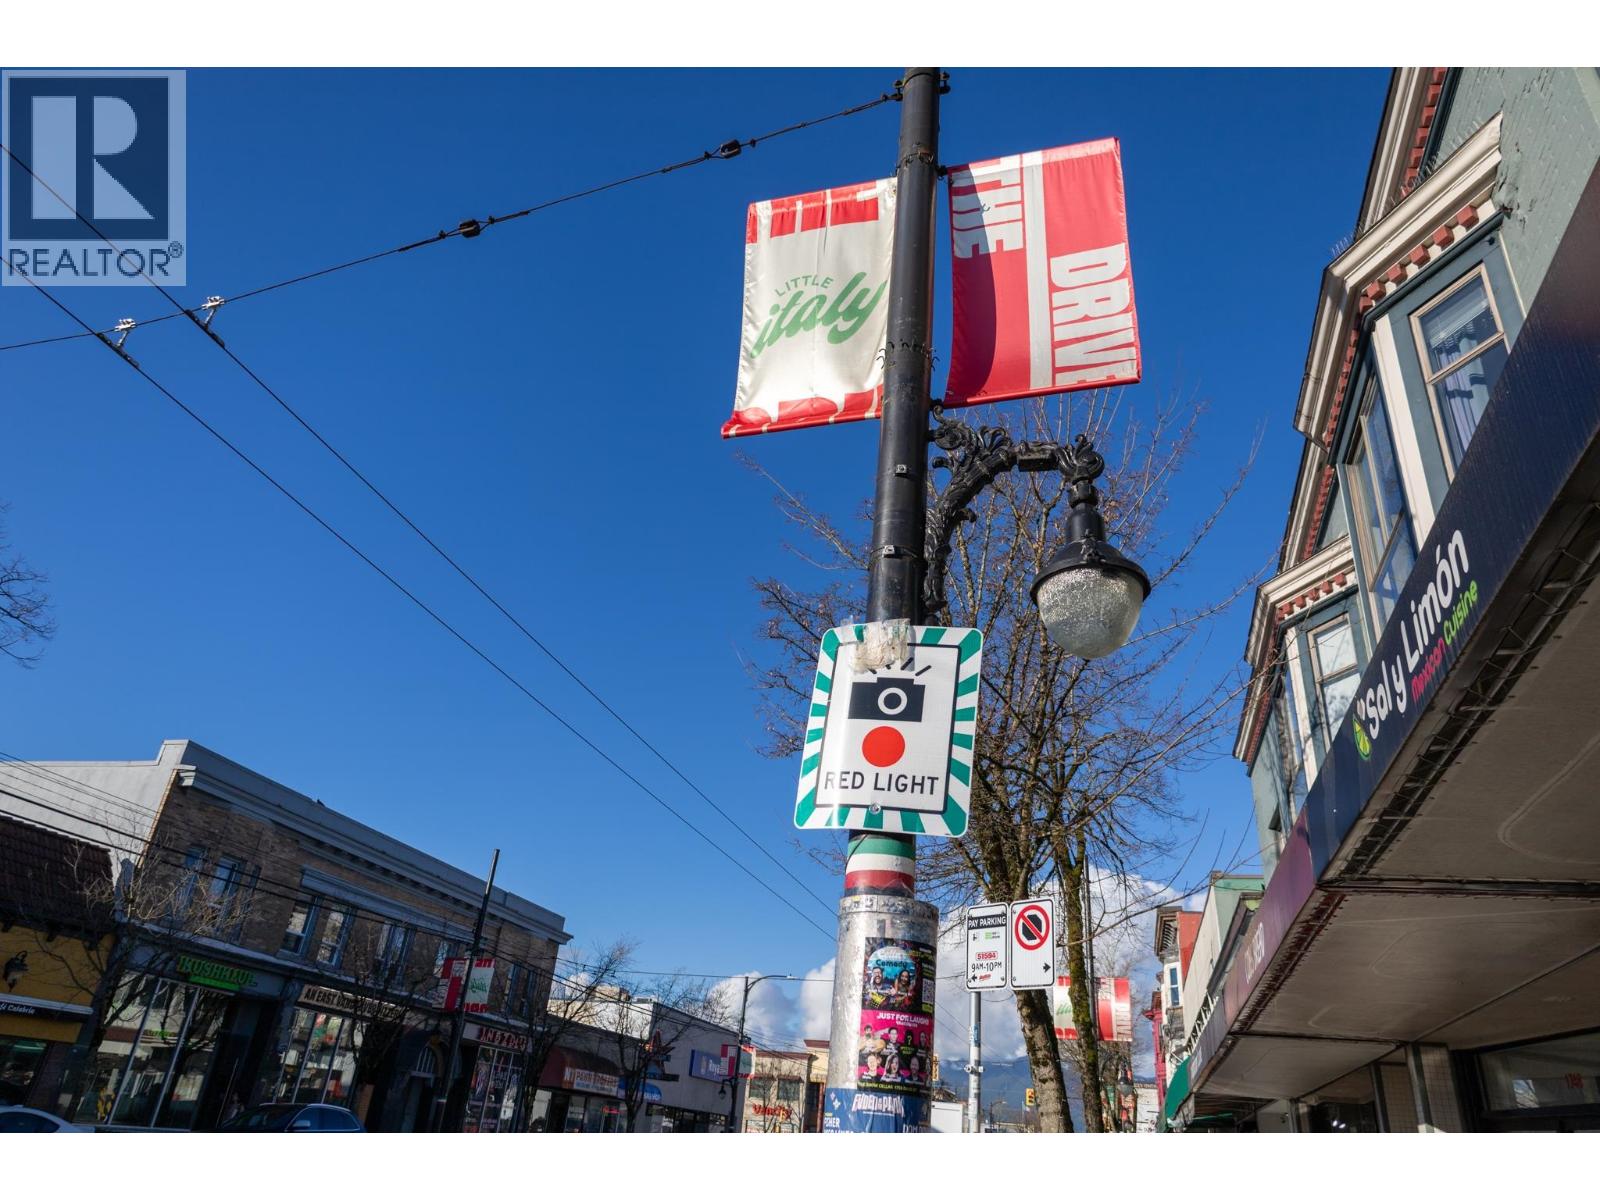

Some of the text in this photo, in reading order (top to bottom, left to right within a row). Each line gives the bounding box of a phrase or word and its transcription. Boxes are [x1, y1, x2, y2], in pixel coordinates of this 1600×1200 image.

[951, 154, 1024, 259] THE
[775, 274, 834, 297] LITTLE
[750, 271, 888, 359] italy
[1391, 654, 1407, 713] y
[1400, 529, 1469, 673] Limón
[823, 770, 939, 795] RED LIGHT
[968, 916, 1006, 928] PAY PARKING
[876, 1012, 896, 1020] JUST
